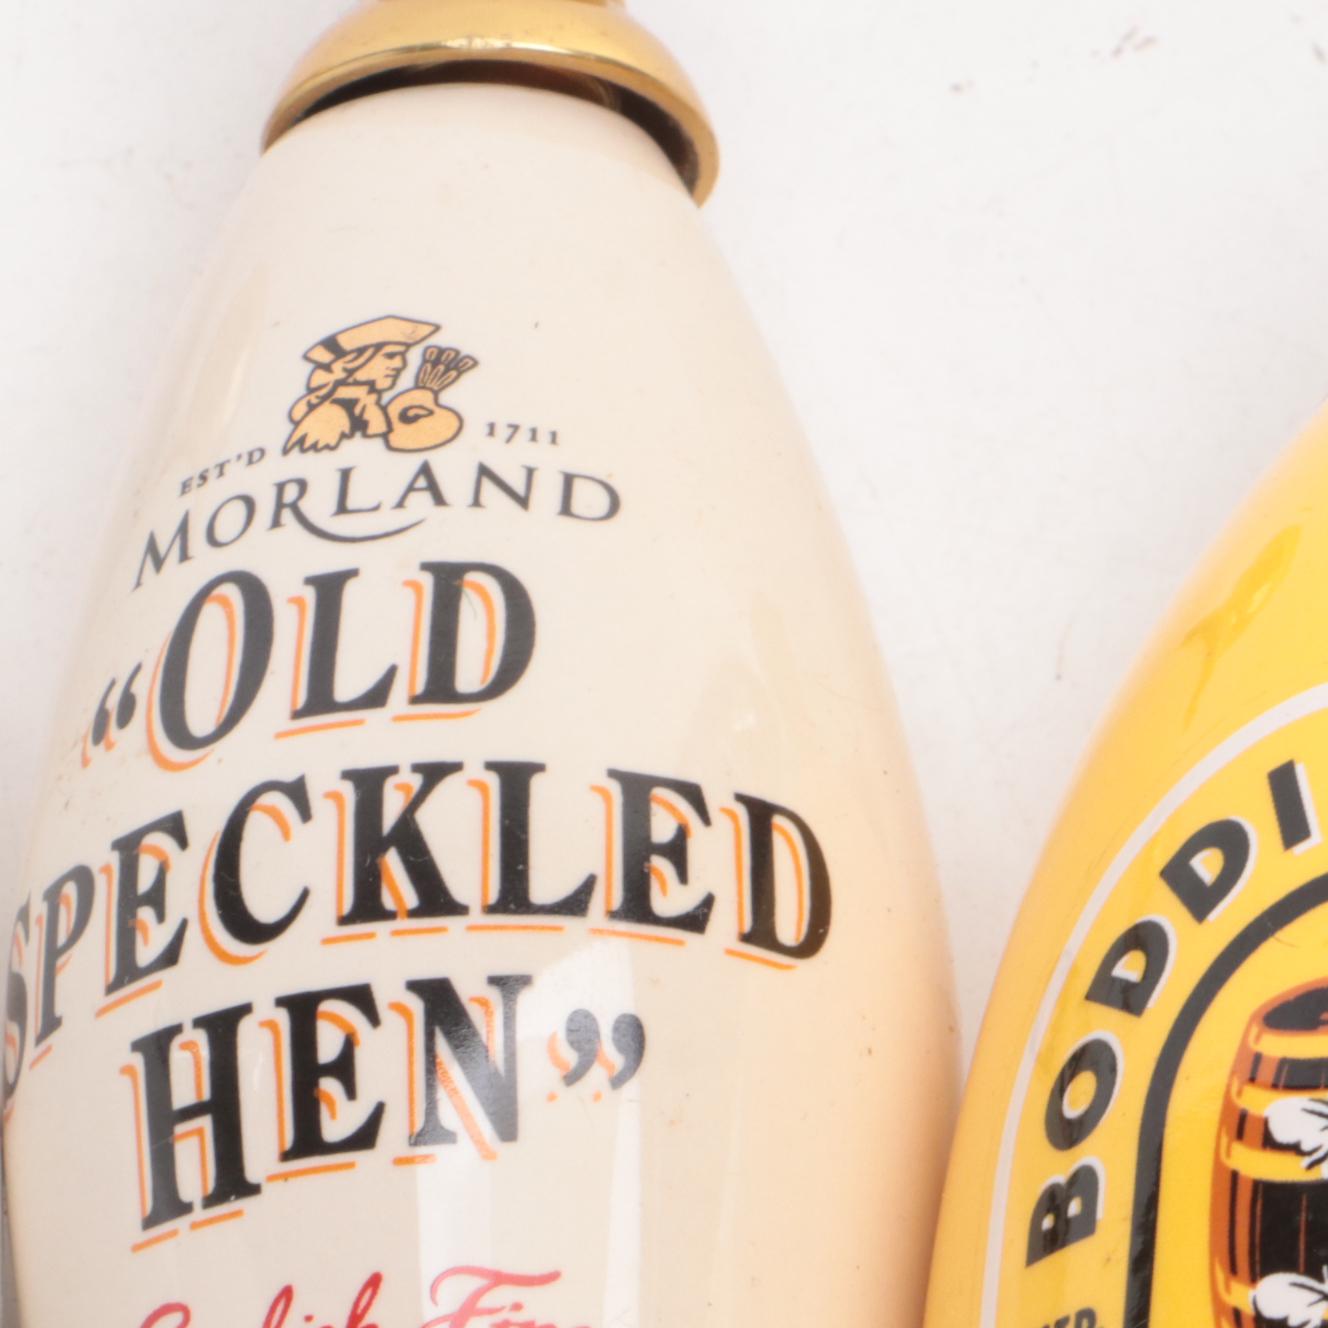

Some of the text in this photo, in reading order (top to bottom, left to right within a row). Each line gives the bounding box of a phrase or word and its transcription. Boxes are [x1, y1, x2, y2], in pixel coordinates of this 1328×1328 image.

[132, 459, 622, 590] MORLAND
[178, 420, 560, 499] EST'D 1711
[0, 760, 834, 1125] SPECKLED
